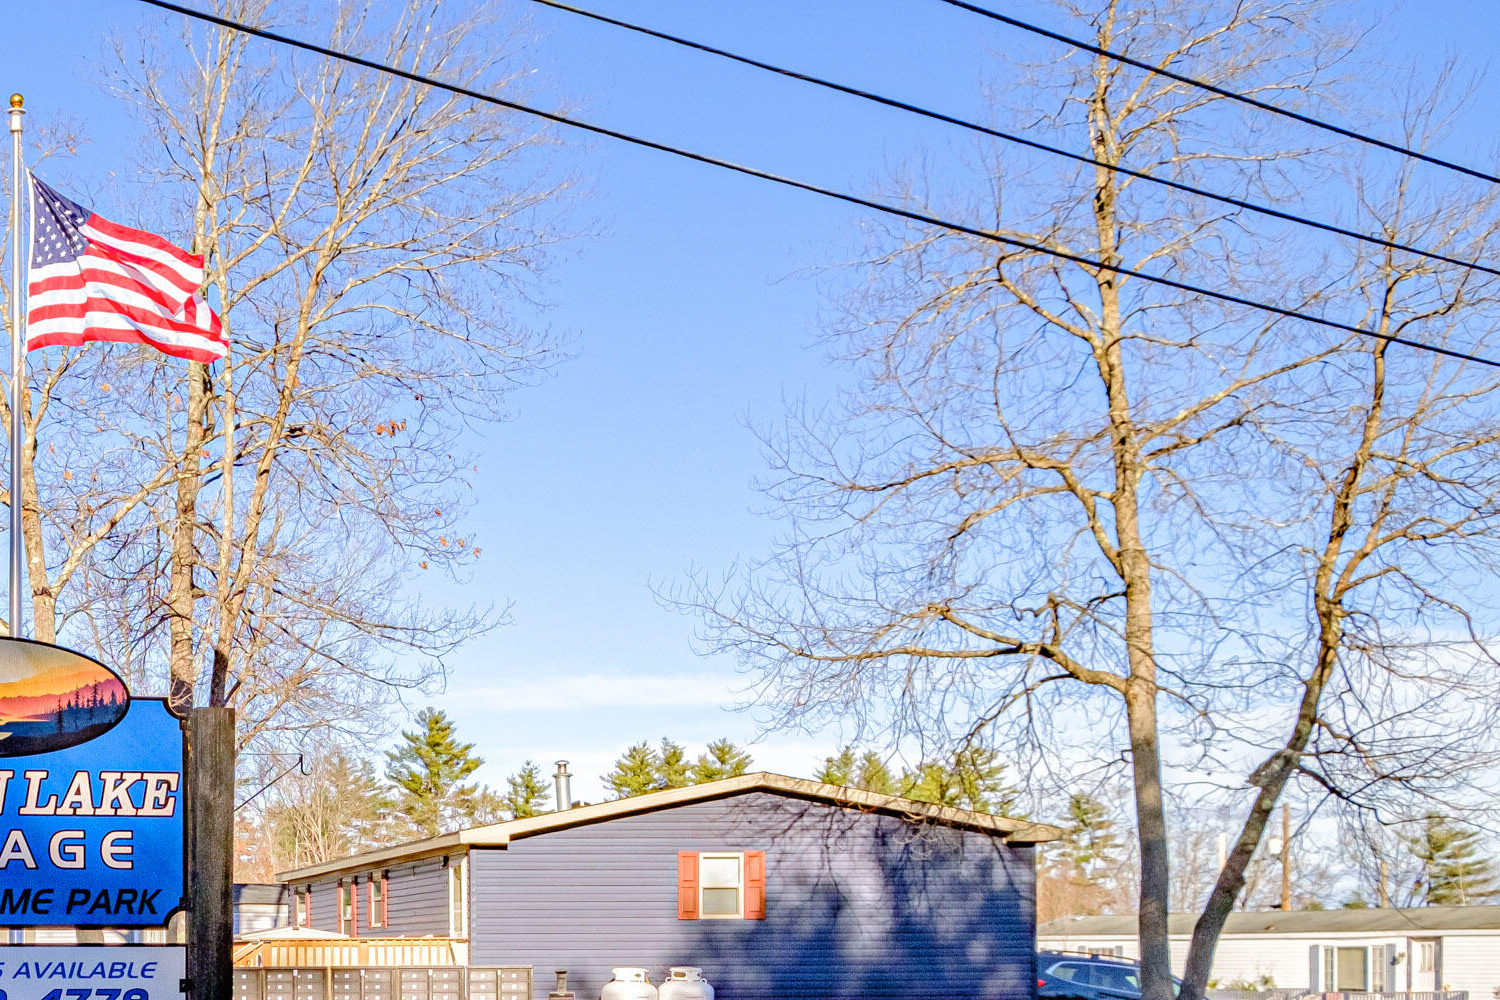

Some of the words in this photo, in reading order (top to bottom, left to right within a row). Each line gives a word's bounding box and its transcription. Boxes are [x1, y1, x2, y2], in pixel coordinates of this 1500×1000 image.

[18, 770, 180, 817] LAKE
[66, 888, 163, 915] PARK
[12, 961, 158, 979] AVAILABLE
